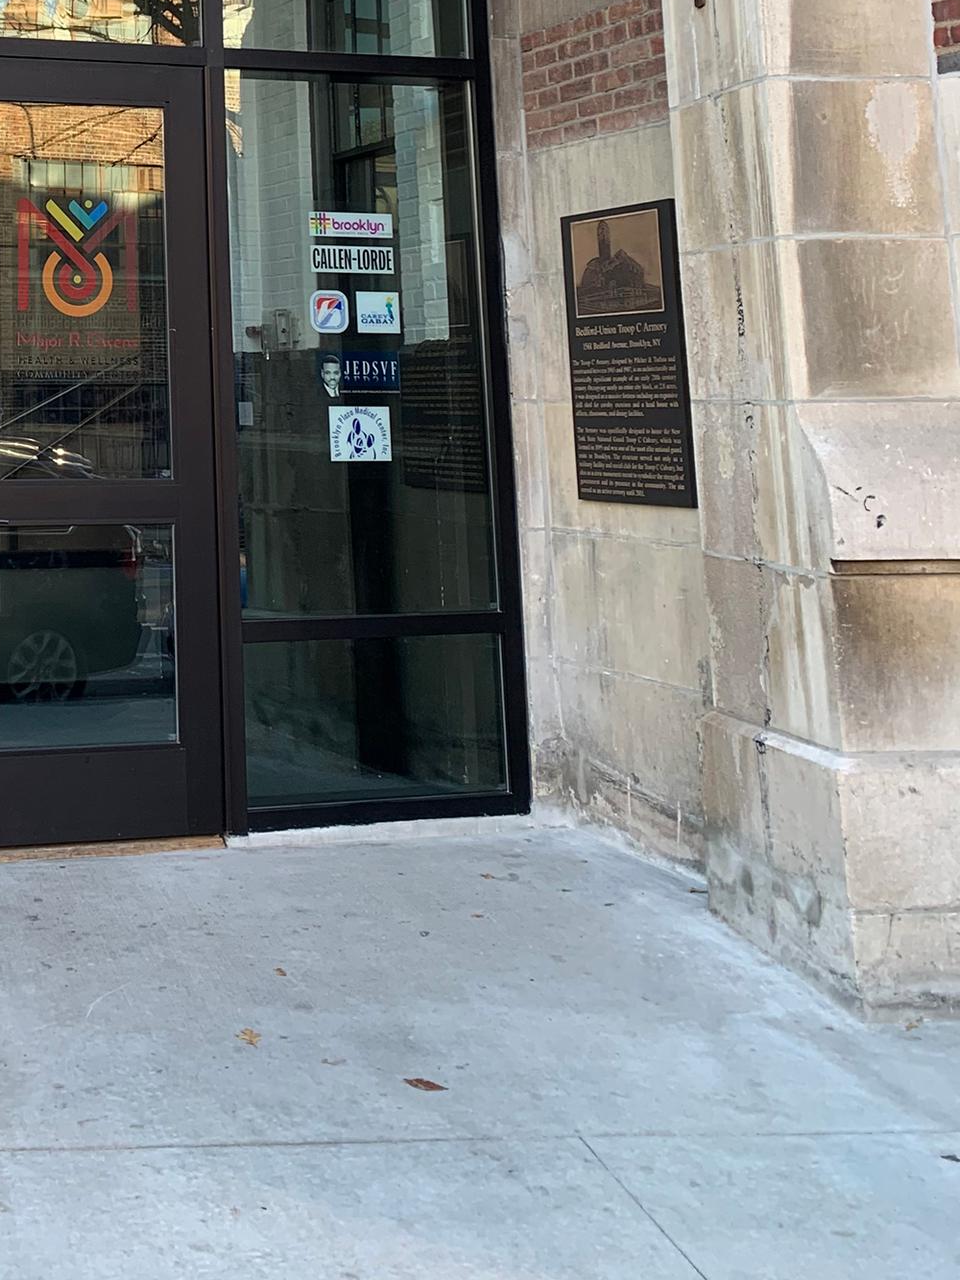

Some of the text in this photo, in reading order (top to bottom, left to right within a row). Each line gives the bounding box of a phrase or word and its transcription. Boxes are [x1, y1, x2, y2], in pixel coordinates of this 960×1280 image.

[332, 217, 385, 235] brooklyn
[312, 247, 392, 271] CALLEN-LORDE
[635, 322, 642, 333] C
[643, 322, 668, 334] Armory
[15, 331, 65, 353] Major
[343, 360, 398, 376] JEDSVF
[331, 424, 342, 458] Brooklyn
[337, 410, 354, 424] Plaza
[354, 407, 378, 420] Medical
